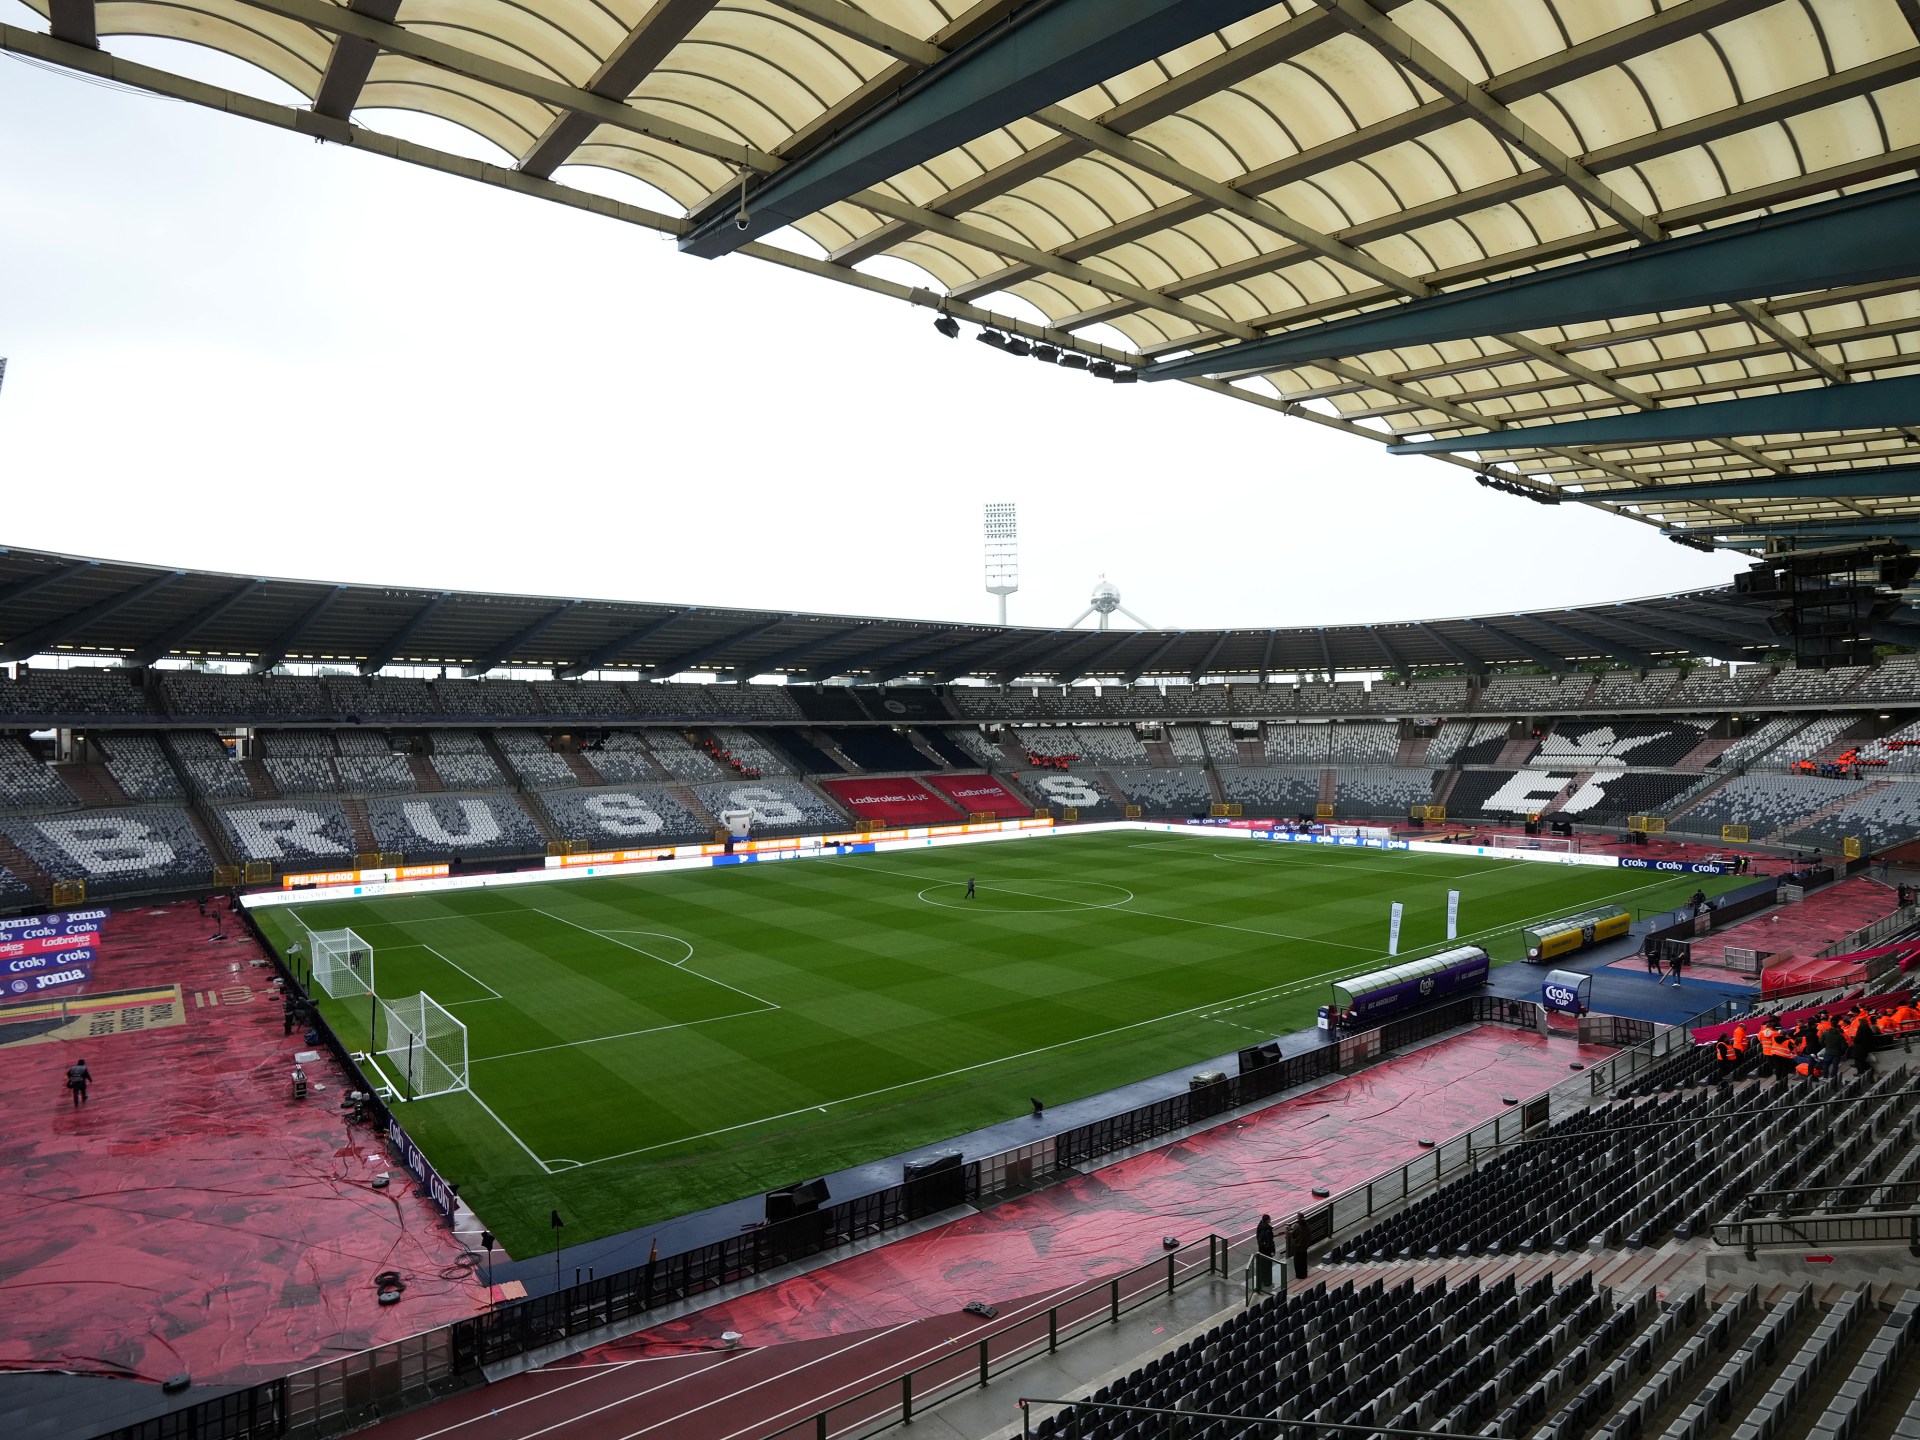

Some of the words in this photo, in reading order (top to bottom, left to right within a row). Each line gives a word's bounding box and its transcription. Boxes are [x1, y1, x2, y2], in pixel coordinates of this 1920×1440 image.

[952, 787, 1002, 797] Ladbrokes
[1622, 858, 1648, 869] Croky
[1655, 861, 1683, 872] Croky
[1691, 863, 1720, 875] Croky
[288, 873, 327, 886] FEELING
[328, 872, 354, 883] GOOD
[23, 926, 56, 939] Croky
[66, 922, 97, 935] Croky
[42, 935, 90, 947] Ladbrokes
[10, 956, 46, 972] Croky
[56, 949, 90, 964] Croky
[1545, 985, 1574, 1002] Croky
[1555, 998, 1569, 1007] CUP
[389, 1119, 404, 1153] Croky
[408, 1144, 425, 1183] Croky
[430, 1174, 450, 1216] Croky
